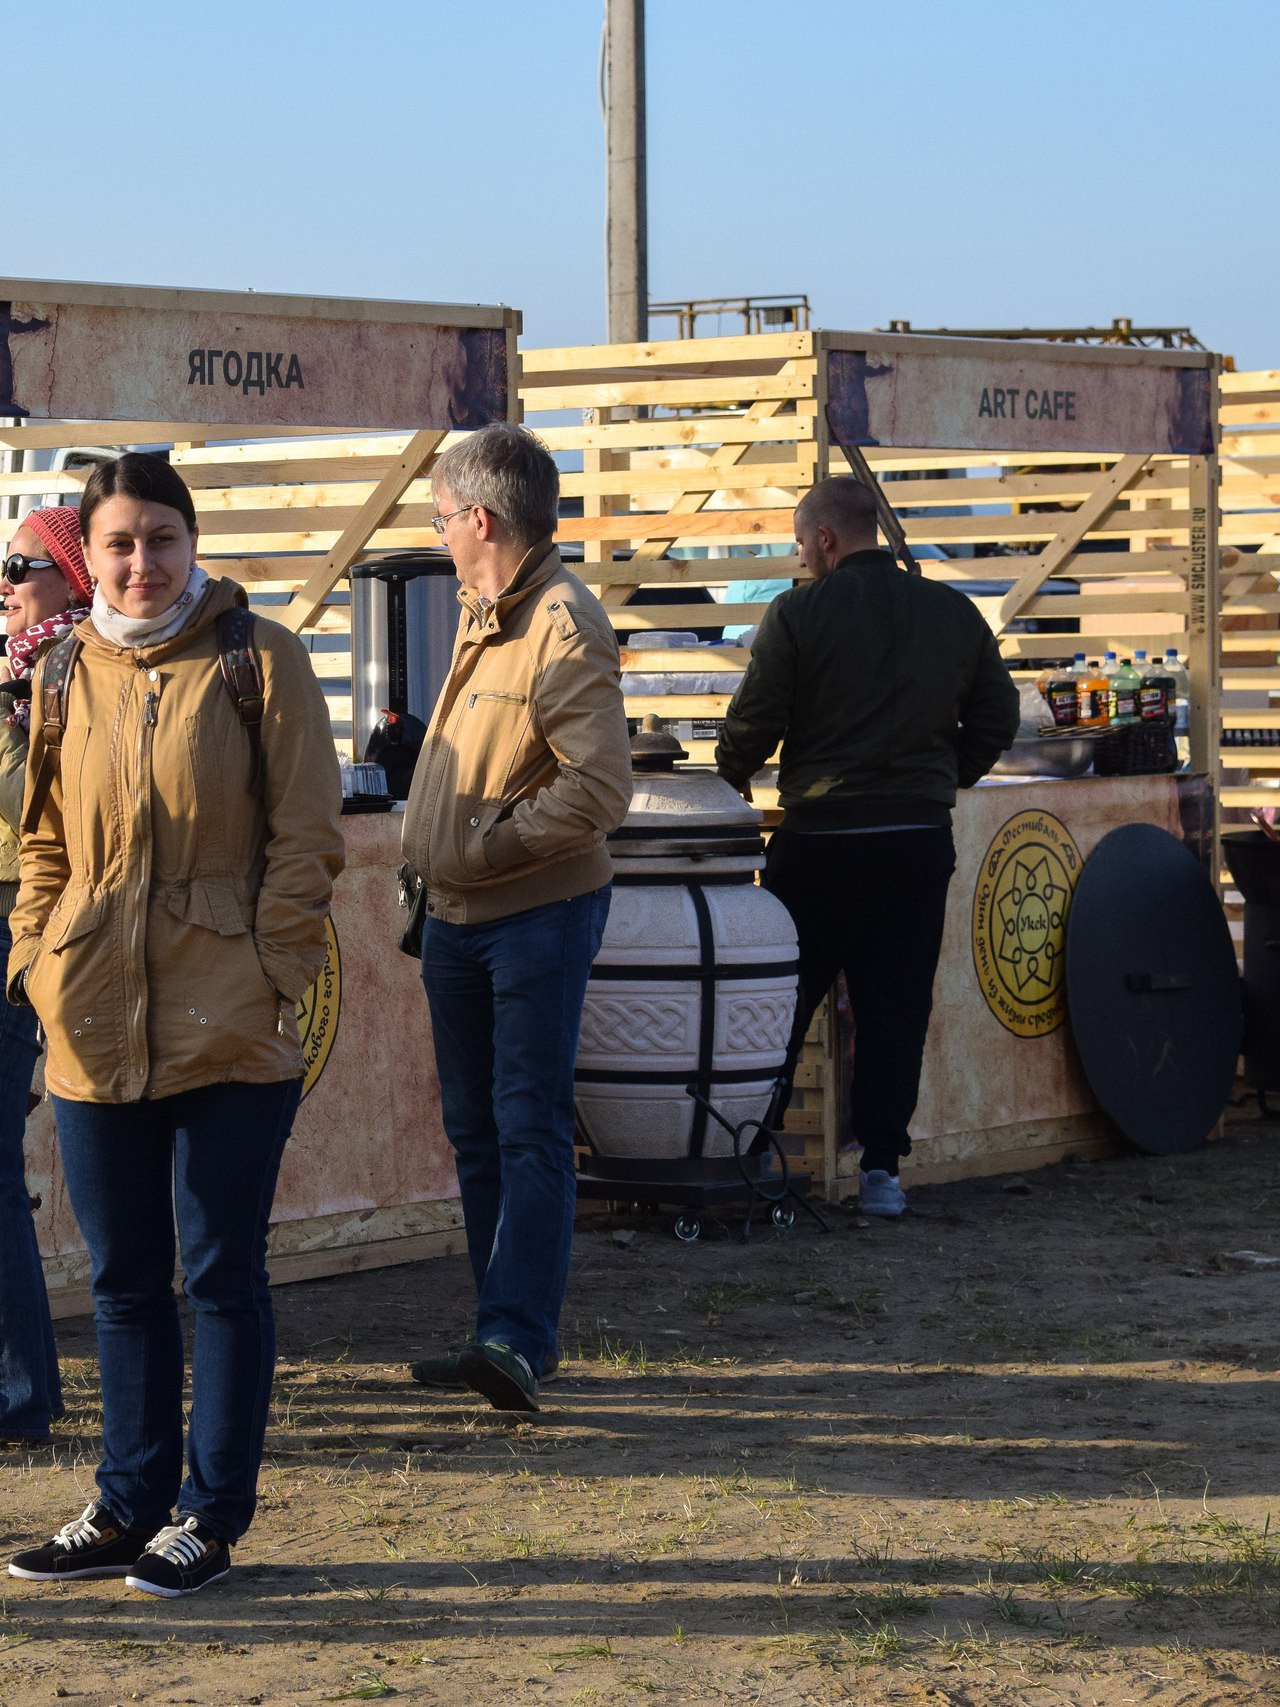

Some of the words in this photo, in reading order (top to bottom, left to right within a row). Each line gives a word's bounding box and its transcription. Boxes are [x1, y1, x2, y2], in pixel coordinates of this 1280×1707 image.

[187, 349, 304, 396] ЯГОДКА
[978, 388, 1019, 419] ART
[1025, 389, 1076, 421] CAFE
[1002, 816, 1060, 846] Фестиваль
[978, 883, 991, 932] Один
[1020, 913, 1047, 932] Укек
[304, 1004, 331, 1076] кового
